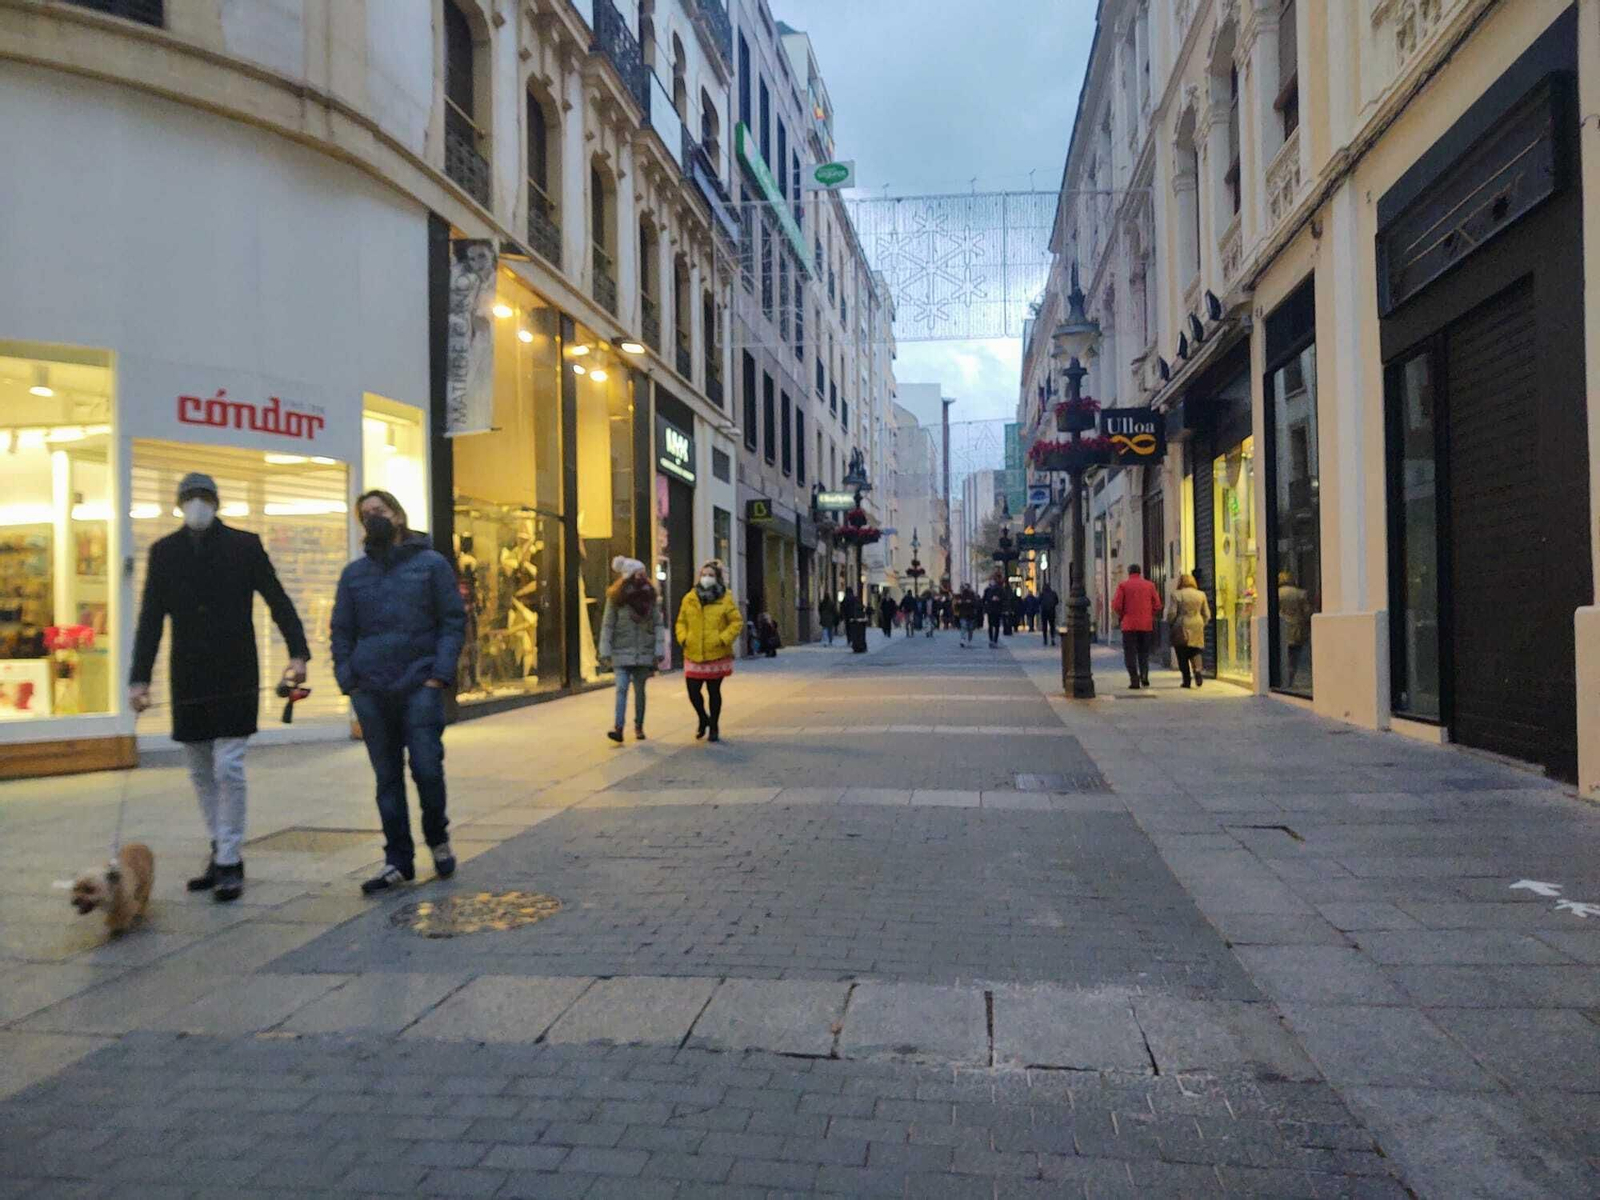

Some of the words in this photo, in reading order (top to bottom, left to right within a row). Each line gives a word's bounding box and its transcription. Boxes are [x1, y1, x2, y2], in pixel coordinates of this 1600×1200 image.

[452, 345, 470, 426] MATILDE
[178, 388, 325, 440] cóndor
[1107, 416, 1156, 434] Ulloa
